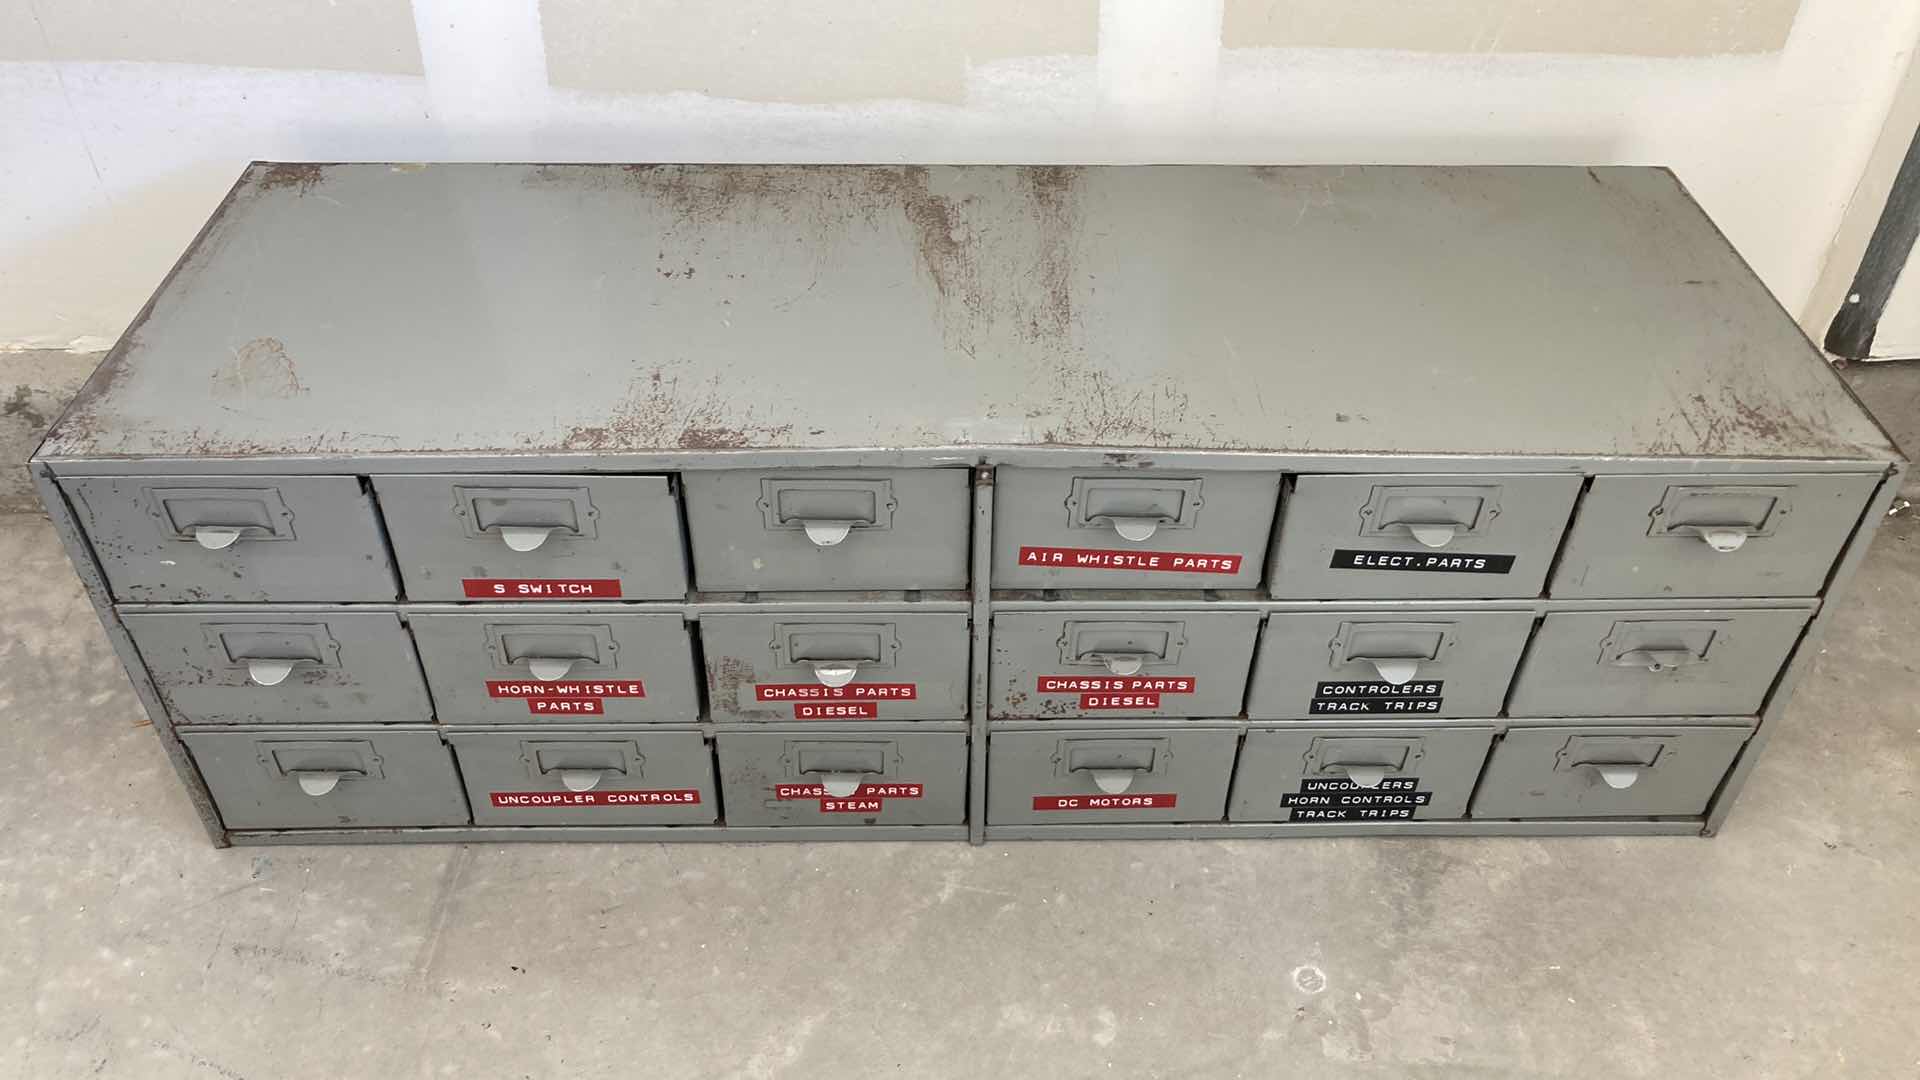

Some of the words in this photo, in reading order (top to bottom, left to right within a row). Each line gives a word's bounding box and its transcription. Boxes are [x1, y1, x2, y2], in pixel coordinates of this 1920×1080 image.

[1026, 551, 1064, 563] AIR
[1077, 553, 1159, 567] WHISTLE
[1173, 558, 1233, 570] PARTS
[1353, 554, 1487, 570] ELECT.PARTS
[492, 583, 506, 594] S
[518, 583, 593, 594] SWITCH
[497, 685, 640, 695] HORN-WHISTLE
[1045, 679, 1124, 691] CHASSIS
[1132, 680, 1189, 691] PARTS
[1322, 683, 1437, 695] CONTROLERS
[763, 687, 844, 697] CHASSIS
[855, 687, 912, 697] PARTS
[1088, 696, 1156, 706] DIESEL
[1316, 701, 1370, 711] TRACK
[1384, 701, 1439, 711] TRIPS
[536, 701, 596, 712] PARTS
[802, 706, 868, 716] DIESEL
[866, 786, 920, 796] PARTS
[498, 795, 595, 804] UNCOUPLER
[607, 791, 695, 803] CONTROLS
[1058, 798, 1079, 808] DC
[1089, 796, 1153, 807] MOTORS
[1287, 795, 1331, 805] HORN
[1340, 795, 1426, 805] CONTROLS
[825, 801, 879, 811] STEAM
[1296, 809, 1347, 819] TRACK
[1359, 809, 1410, 819] TRIPS
